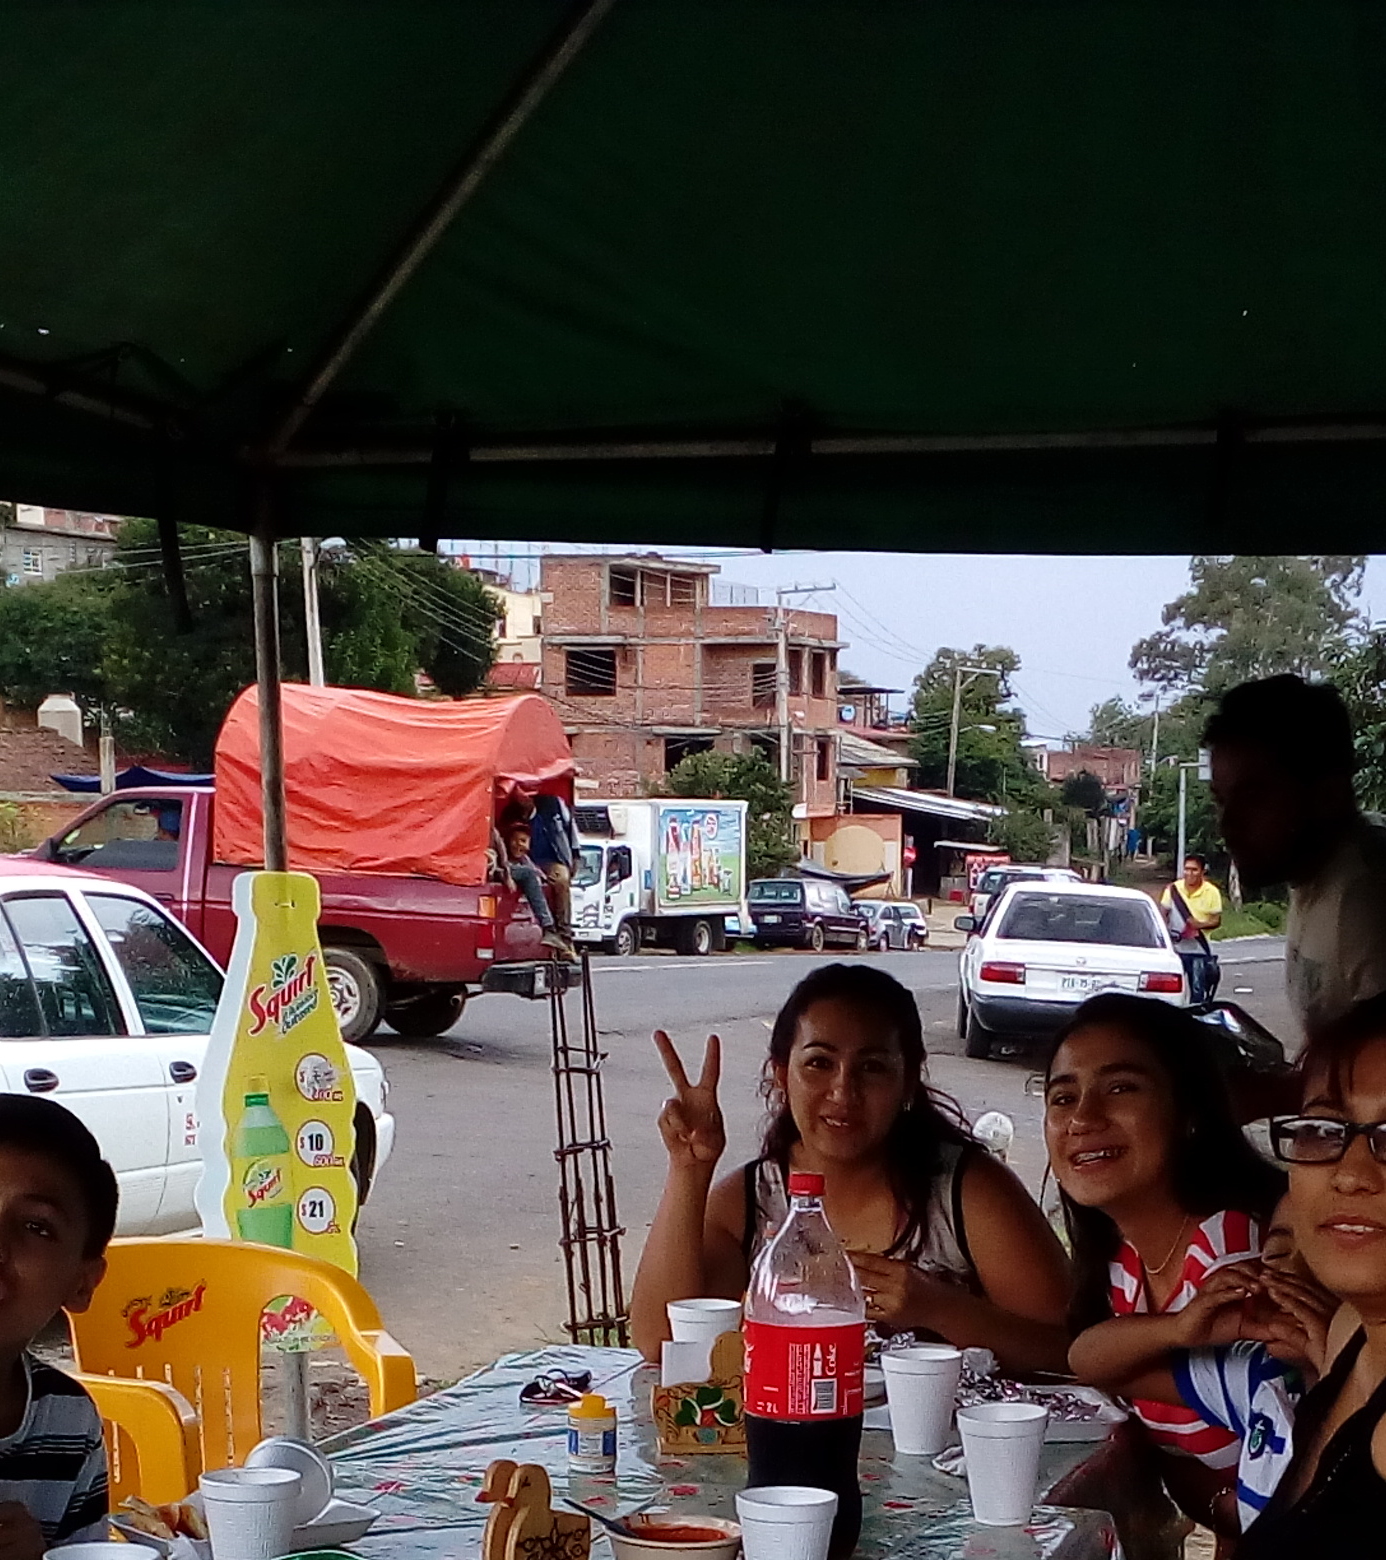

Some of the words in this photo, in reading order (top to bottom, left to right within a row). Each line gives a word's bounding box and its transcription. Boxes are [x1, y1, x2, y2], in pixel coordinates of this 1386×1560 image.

[248, 955, 316, 1036] Squirt
[308, 1133, 324, 1151] 10
[247, 1167, 282, 1209] Squirt
[309, 1201, 324, 1218] 21
[125, 1282, 206, 1349] Squirt
[825, 1342, 837, 1377] Coke
